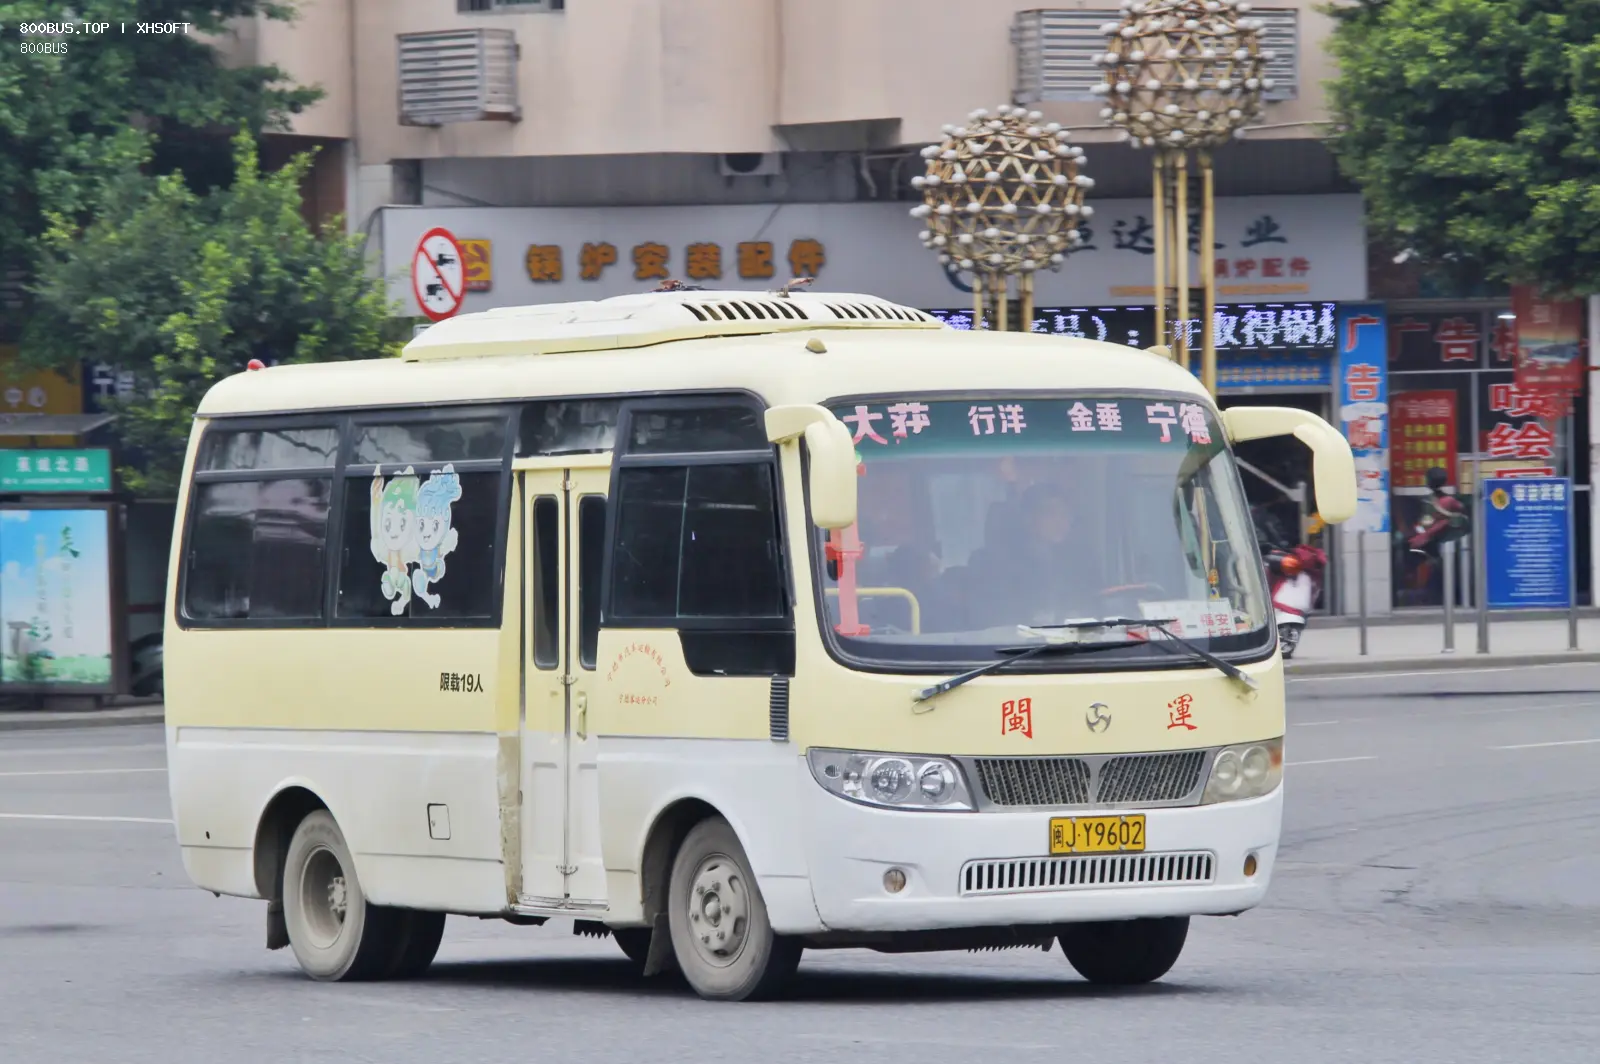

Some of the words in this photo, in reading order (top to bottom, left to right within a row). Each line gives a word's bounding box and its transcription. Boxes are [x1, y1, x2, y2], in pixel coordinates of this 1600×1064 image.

[526, 239, 825, 281] 锅炉安装配件
[967, 404, 1027, 436] 行洋
[1067, 402, 1122, 432] 金垂
[1146, 403, 1212, 444] 宁德
[1488, 383, 1556, 477] 喷绘
[440, 672, 484, 693] 限载19人
[1001, 697, 1033, 739] 閩
[1167, 694, 1198, 731] 運
[1053, 821, 1143, 849] 闽J·Y9602
